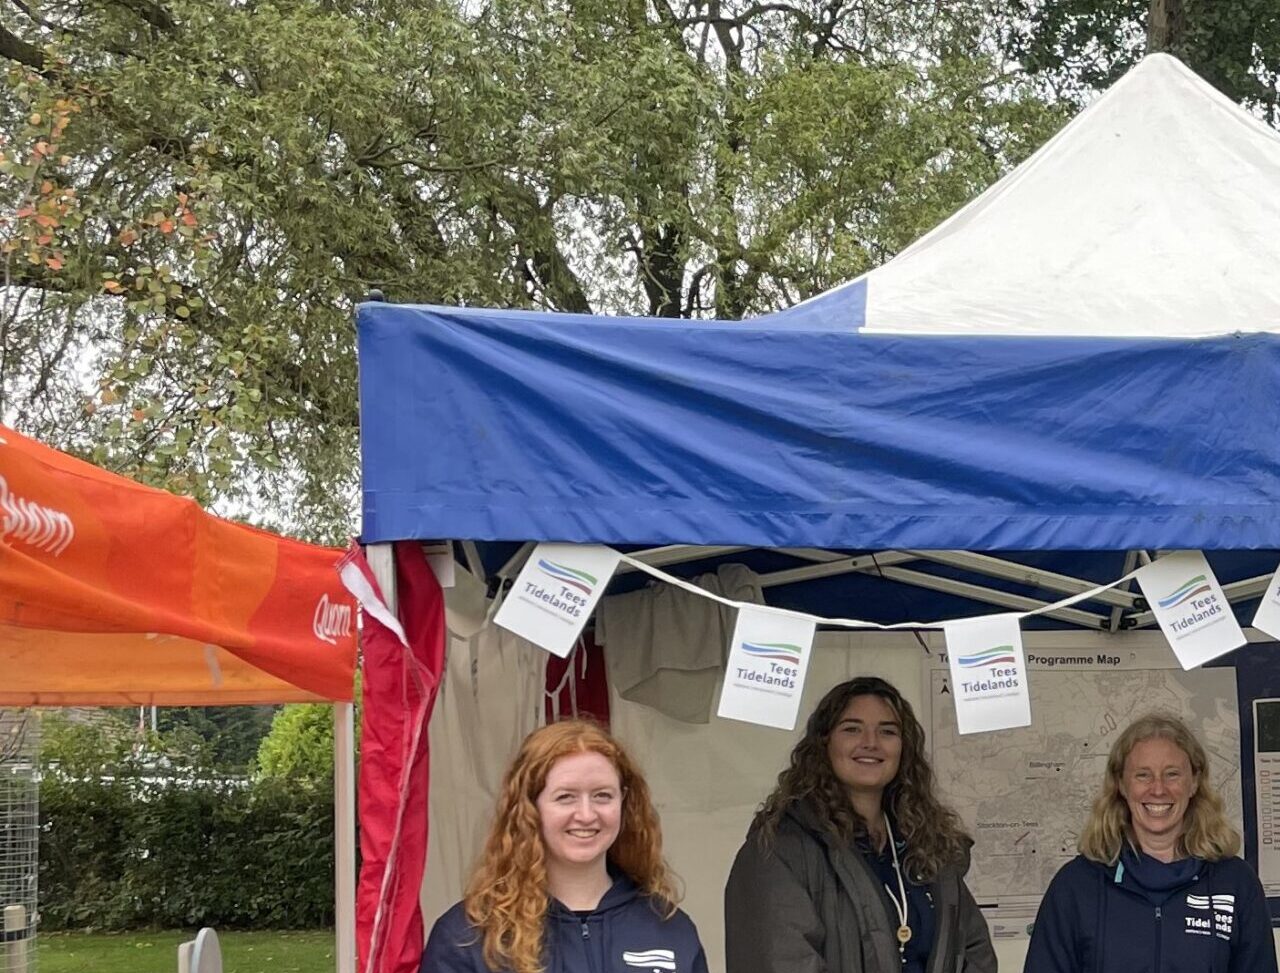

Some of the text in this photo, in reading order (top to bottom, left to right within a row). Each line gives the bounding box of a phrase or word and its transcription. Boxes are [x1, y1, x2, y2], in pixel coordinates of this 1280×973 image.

[524, 582, 581, 617] Tidelands
[560, 586, 588, 607] Tees
[1190, 594, 1218, 611] Tees
[1170, 603, 1223, 633] Tidelands
[1027, 654, 1094, 667] Programme
[1097, 654, 1121, 667] Map
[737, 667, 796, 689] Tidelands
[770, 662, 798, 678] Tees
[990, 667, 1018, 679] Tees
[961, 678, 1019, 694] Tidelands
[1214, 911, 1233, 924] ees
